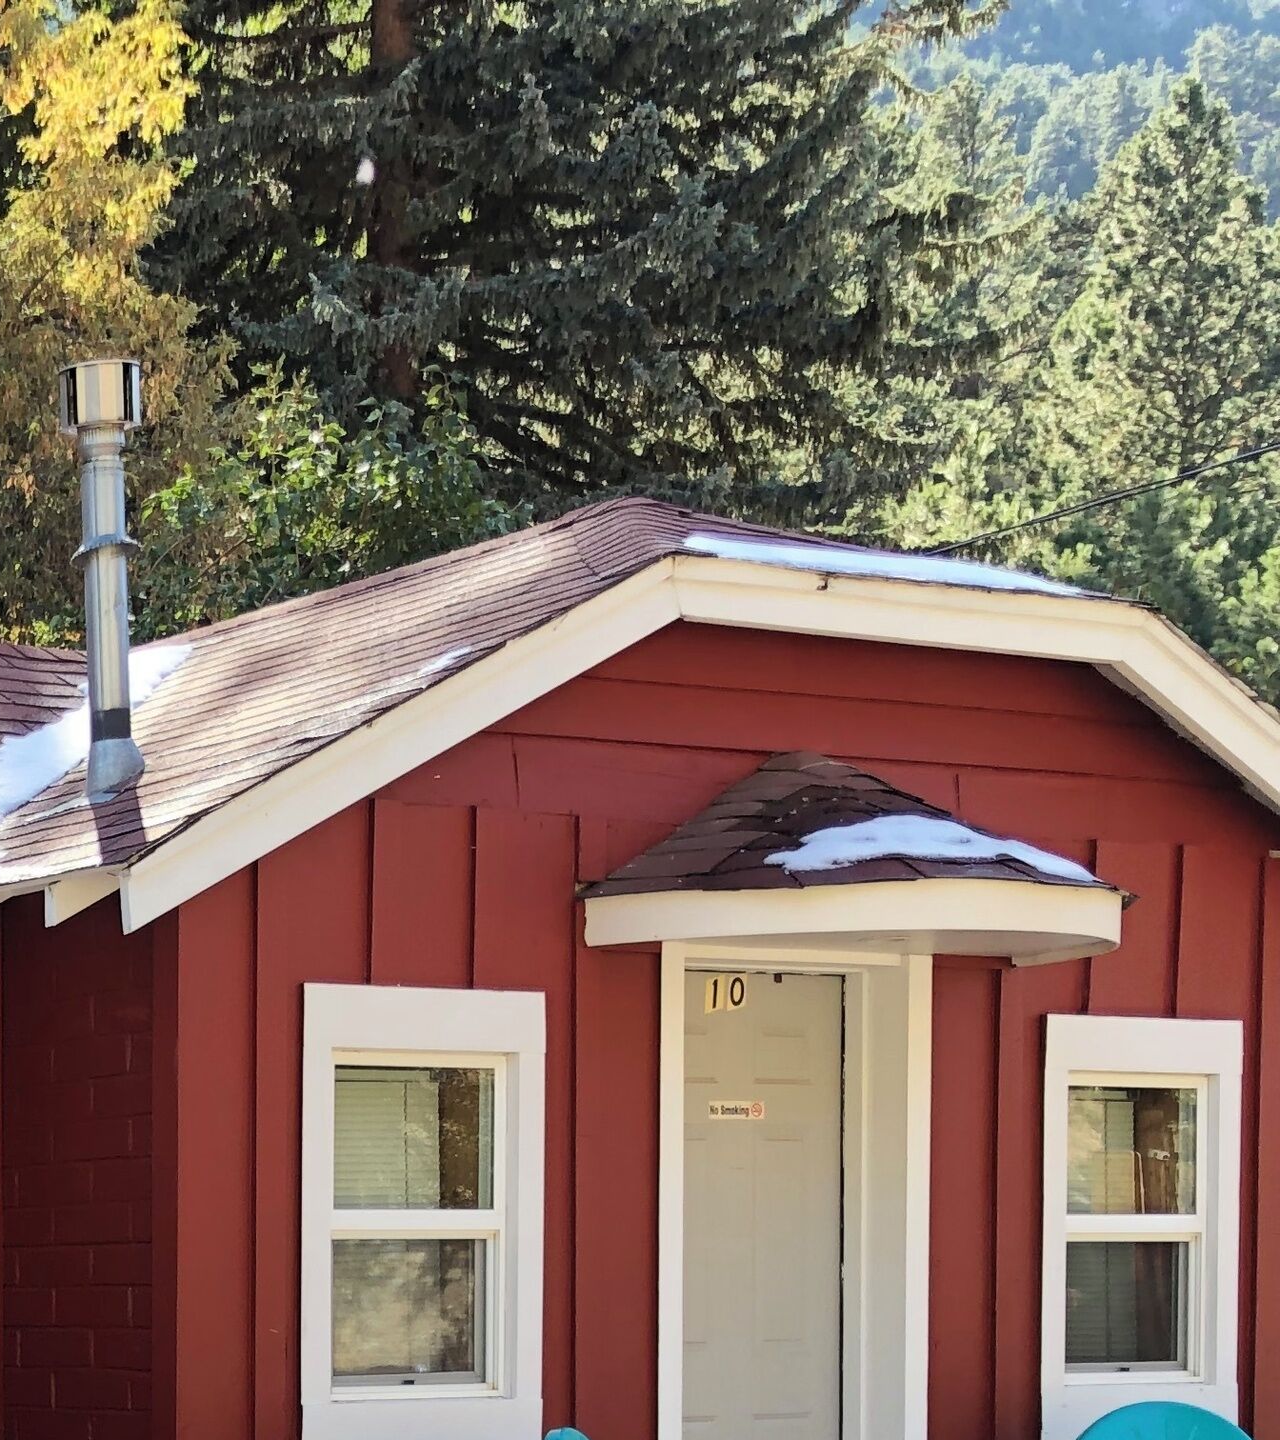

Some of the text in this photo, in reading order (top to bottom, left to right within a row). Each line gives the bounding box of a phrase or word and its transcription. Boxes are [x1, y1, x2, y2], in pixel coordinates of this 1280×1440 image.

[712, 976, 745, 1010] 10
[709, 1104, 750, 1117] No Smoking
